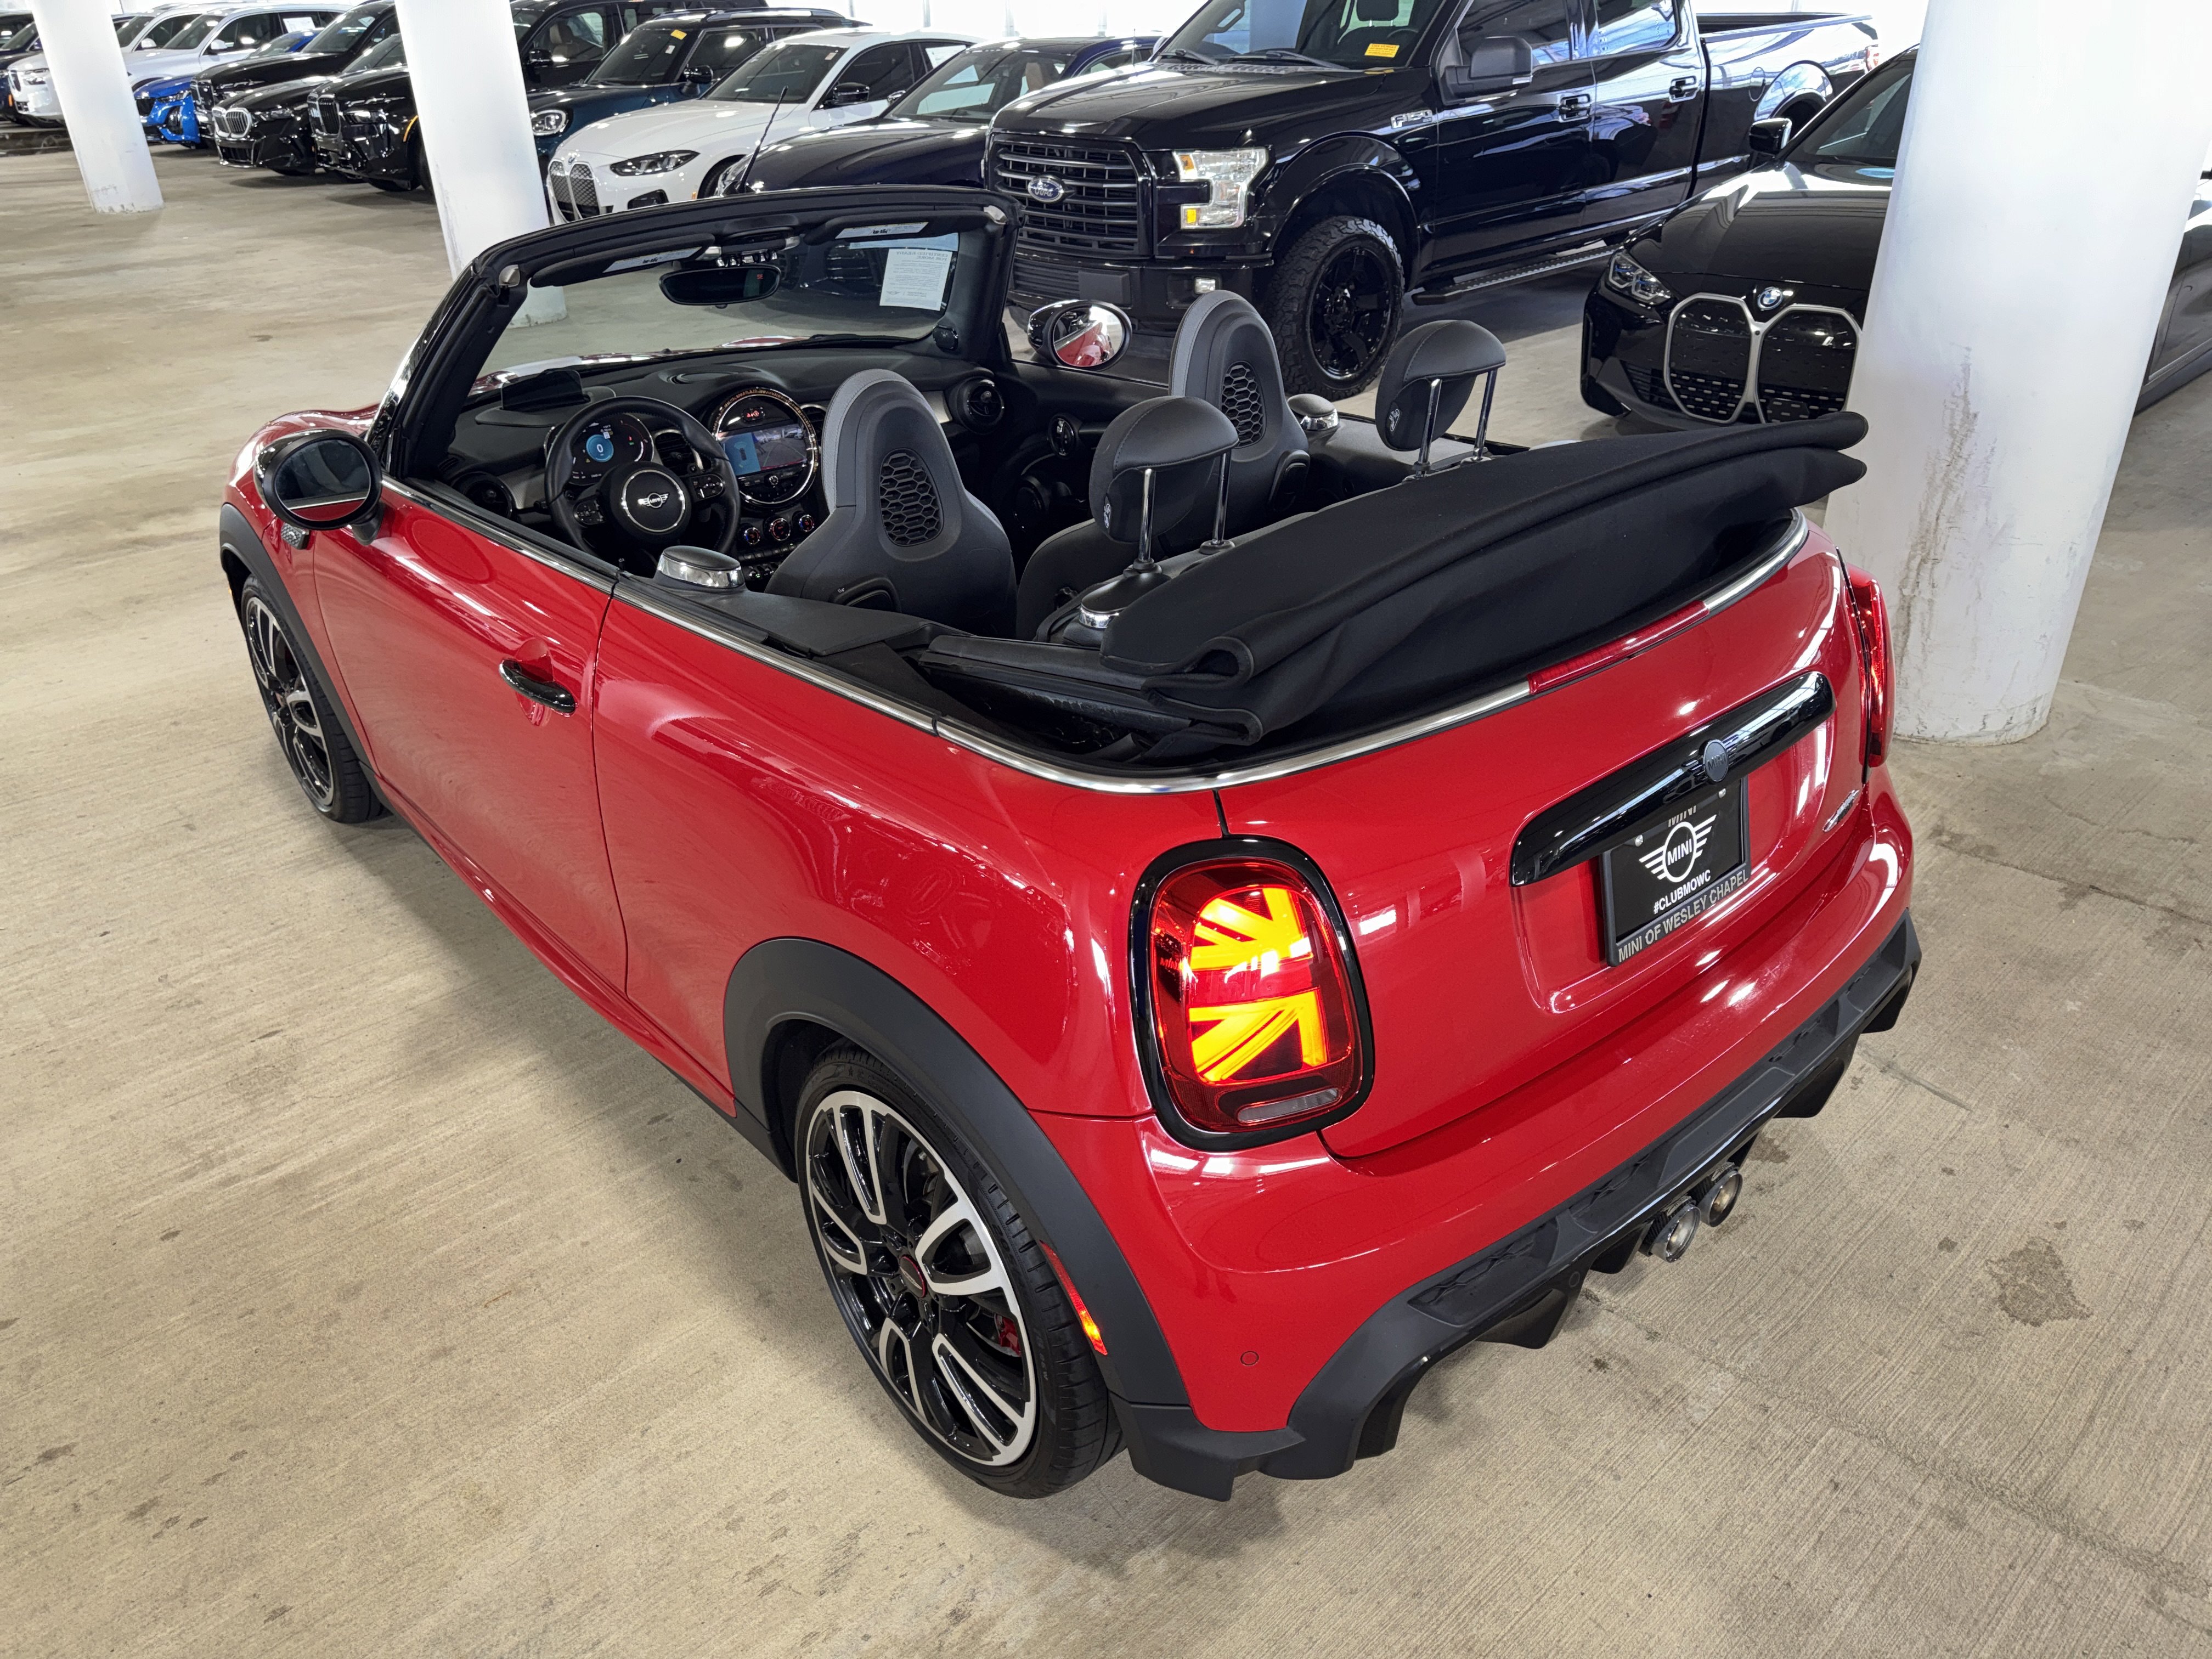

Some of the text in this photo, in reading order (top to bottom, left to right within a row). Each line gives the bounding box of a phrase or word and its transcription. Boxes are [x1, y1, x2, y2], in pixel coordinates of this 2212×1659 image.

[1667, 838, 1692, 866] MINI
[1654, 870, 1711, 915] #CLUBMOWC
[1618, 869, 1749, 963] MINI OF WESLEY CHAPEL
